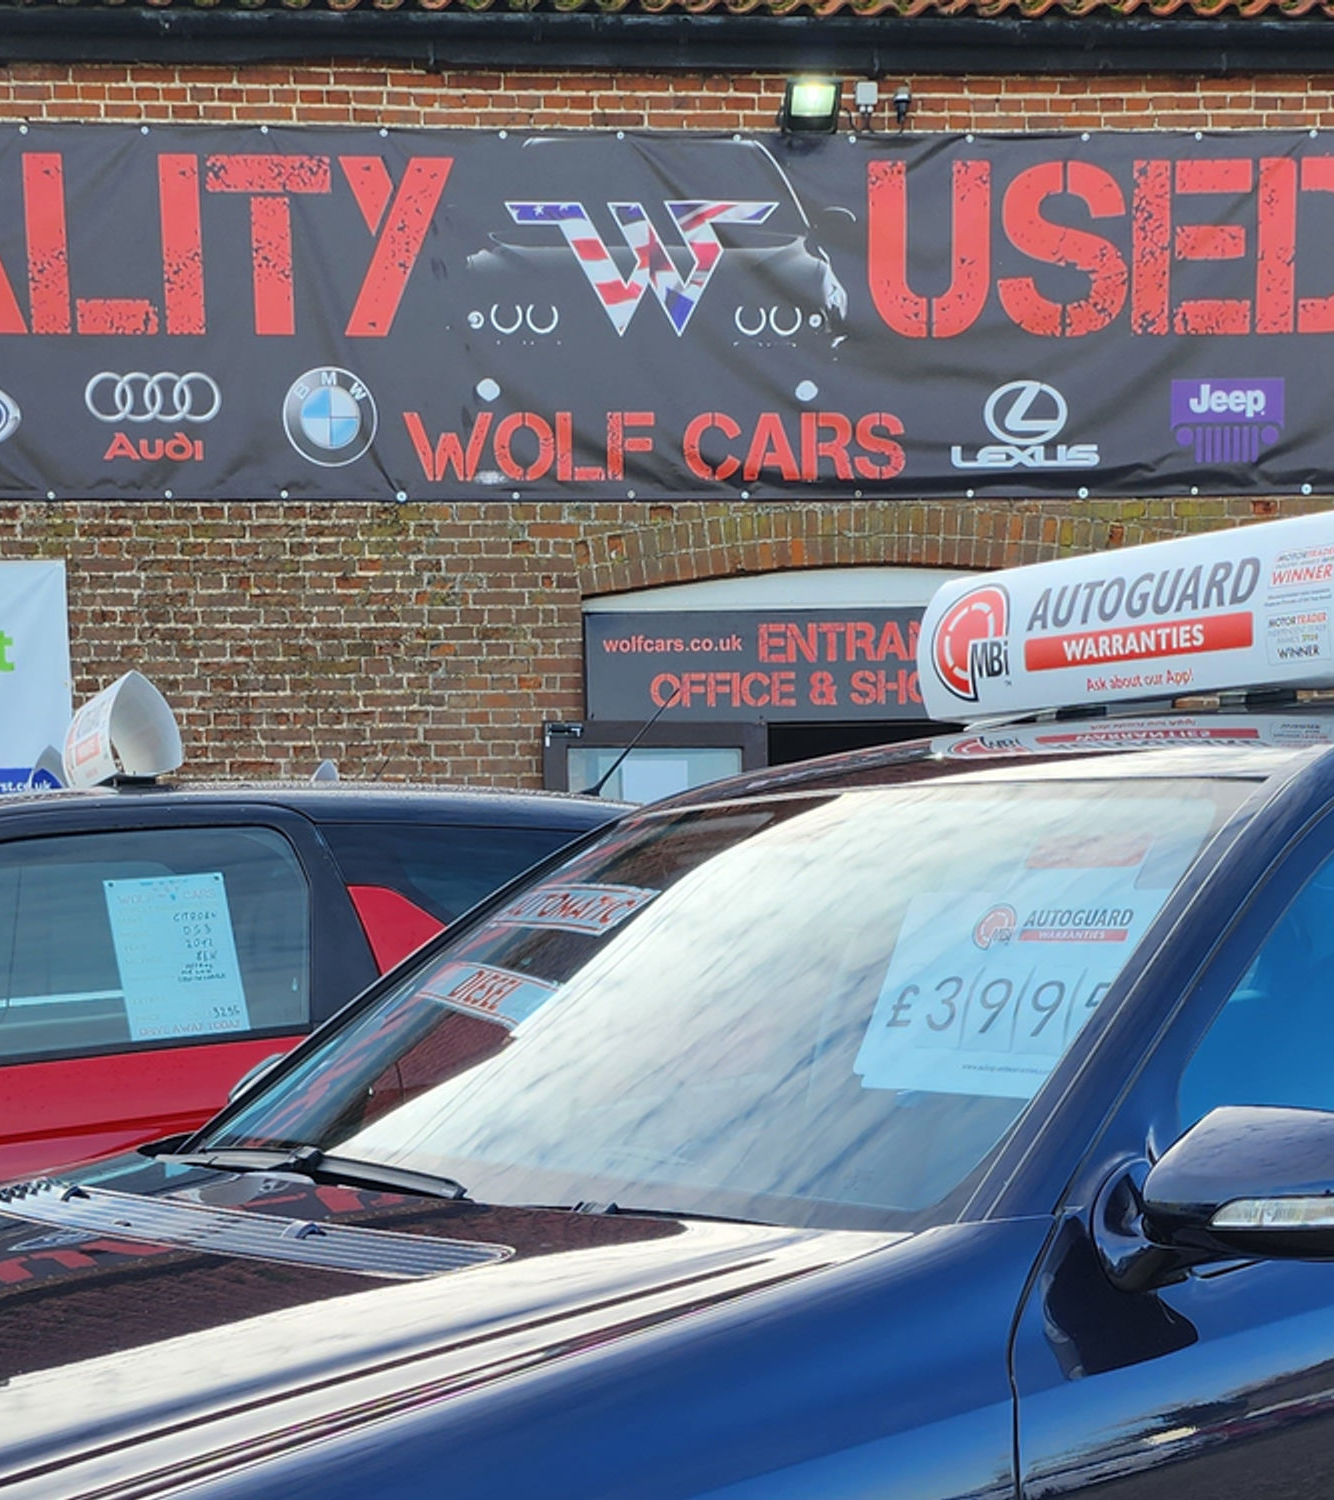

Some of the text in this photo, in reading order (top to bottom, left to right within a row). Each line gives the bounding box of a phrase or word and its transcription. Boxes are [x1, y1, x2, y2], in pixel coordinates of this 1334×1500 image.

[293, 371, 367, 400] BMW
[1188, 383, 1267, 419] Jeep
[103, 432, 204, 462] Audi
[403, 411, 907, 483] WOLF CARS
[951, 443, 1101, 468] LEXUS
[1271, 563, 1334, 586] WINNER
[1026, 556, 1262, 632] AUTOGUARD
[602, 634, 743, 654] wolfcars.co.uk
[1062, 624, 1205, 662] WARRANTIES
[1277, 644, 1320, 659] WINNER
[970, 640, 1011, 680] MBi
[650, 668, 925, 708] OFFICE & SHO
[1087, 668, 1195, 693] Ask about our App!
[1023, 907, 1134, 928] AUTOGUARD
[448, 969, 524, 1011] DIESEL
